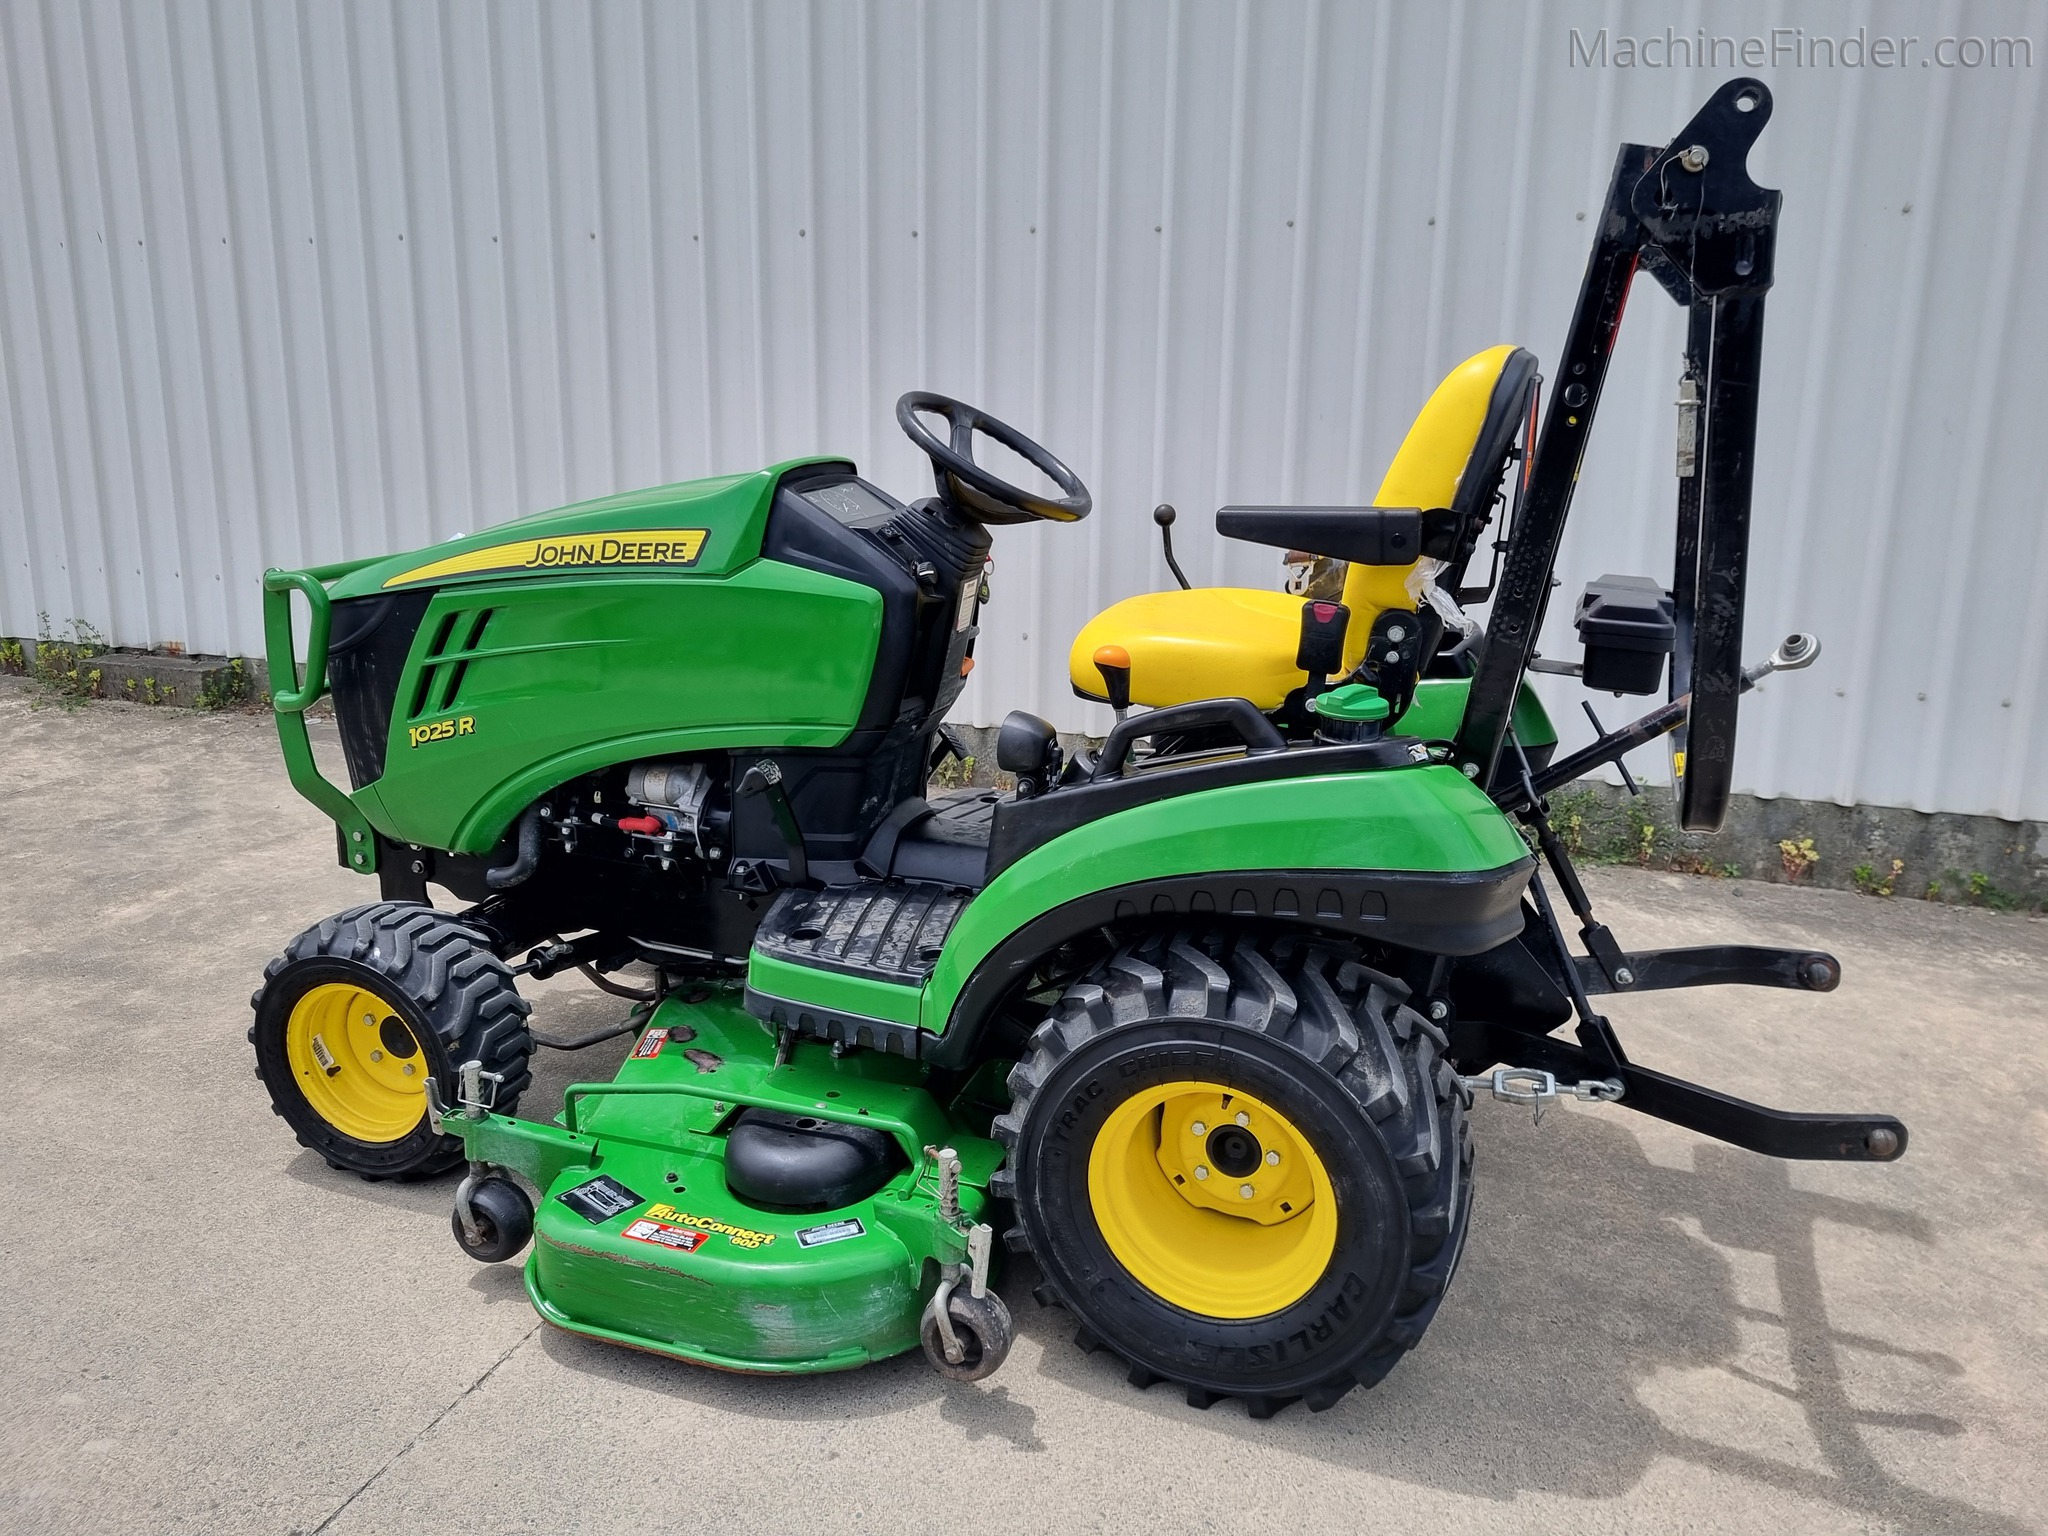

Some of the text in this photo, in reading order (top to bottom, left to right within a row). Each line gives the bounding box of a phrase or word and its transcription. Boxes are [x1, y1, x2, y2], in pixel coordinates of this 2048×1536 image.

[526, 539, 687, 565] JOHN DEERE
[409, 716, 475, 748] 1025 R
[1054, 1050, 1215, 1142] TRAC CHIEF
[648, 1207, 776, 1245] AutoConnect
[731, 1237, 761, 1249] 60D
[1188, 1271, 1368, 1370] CARLISLE
